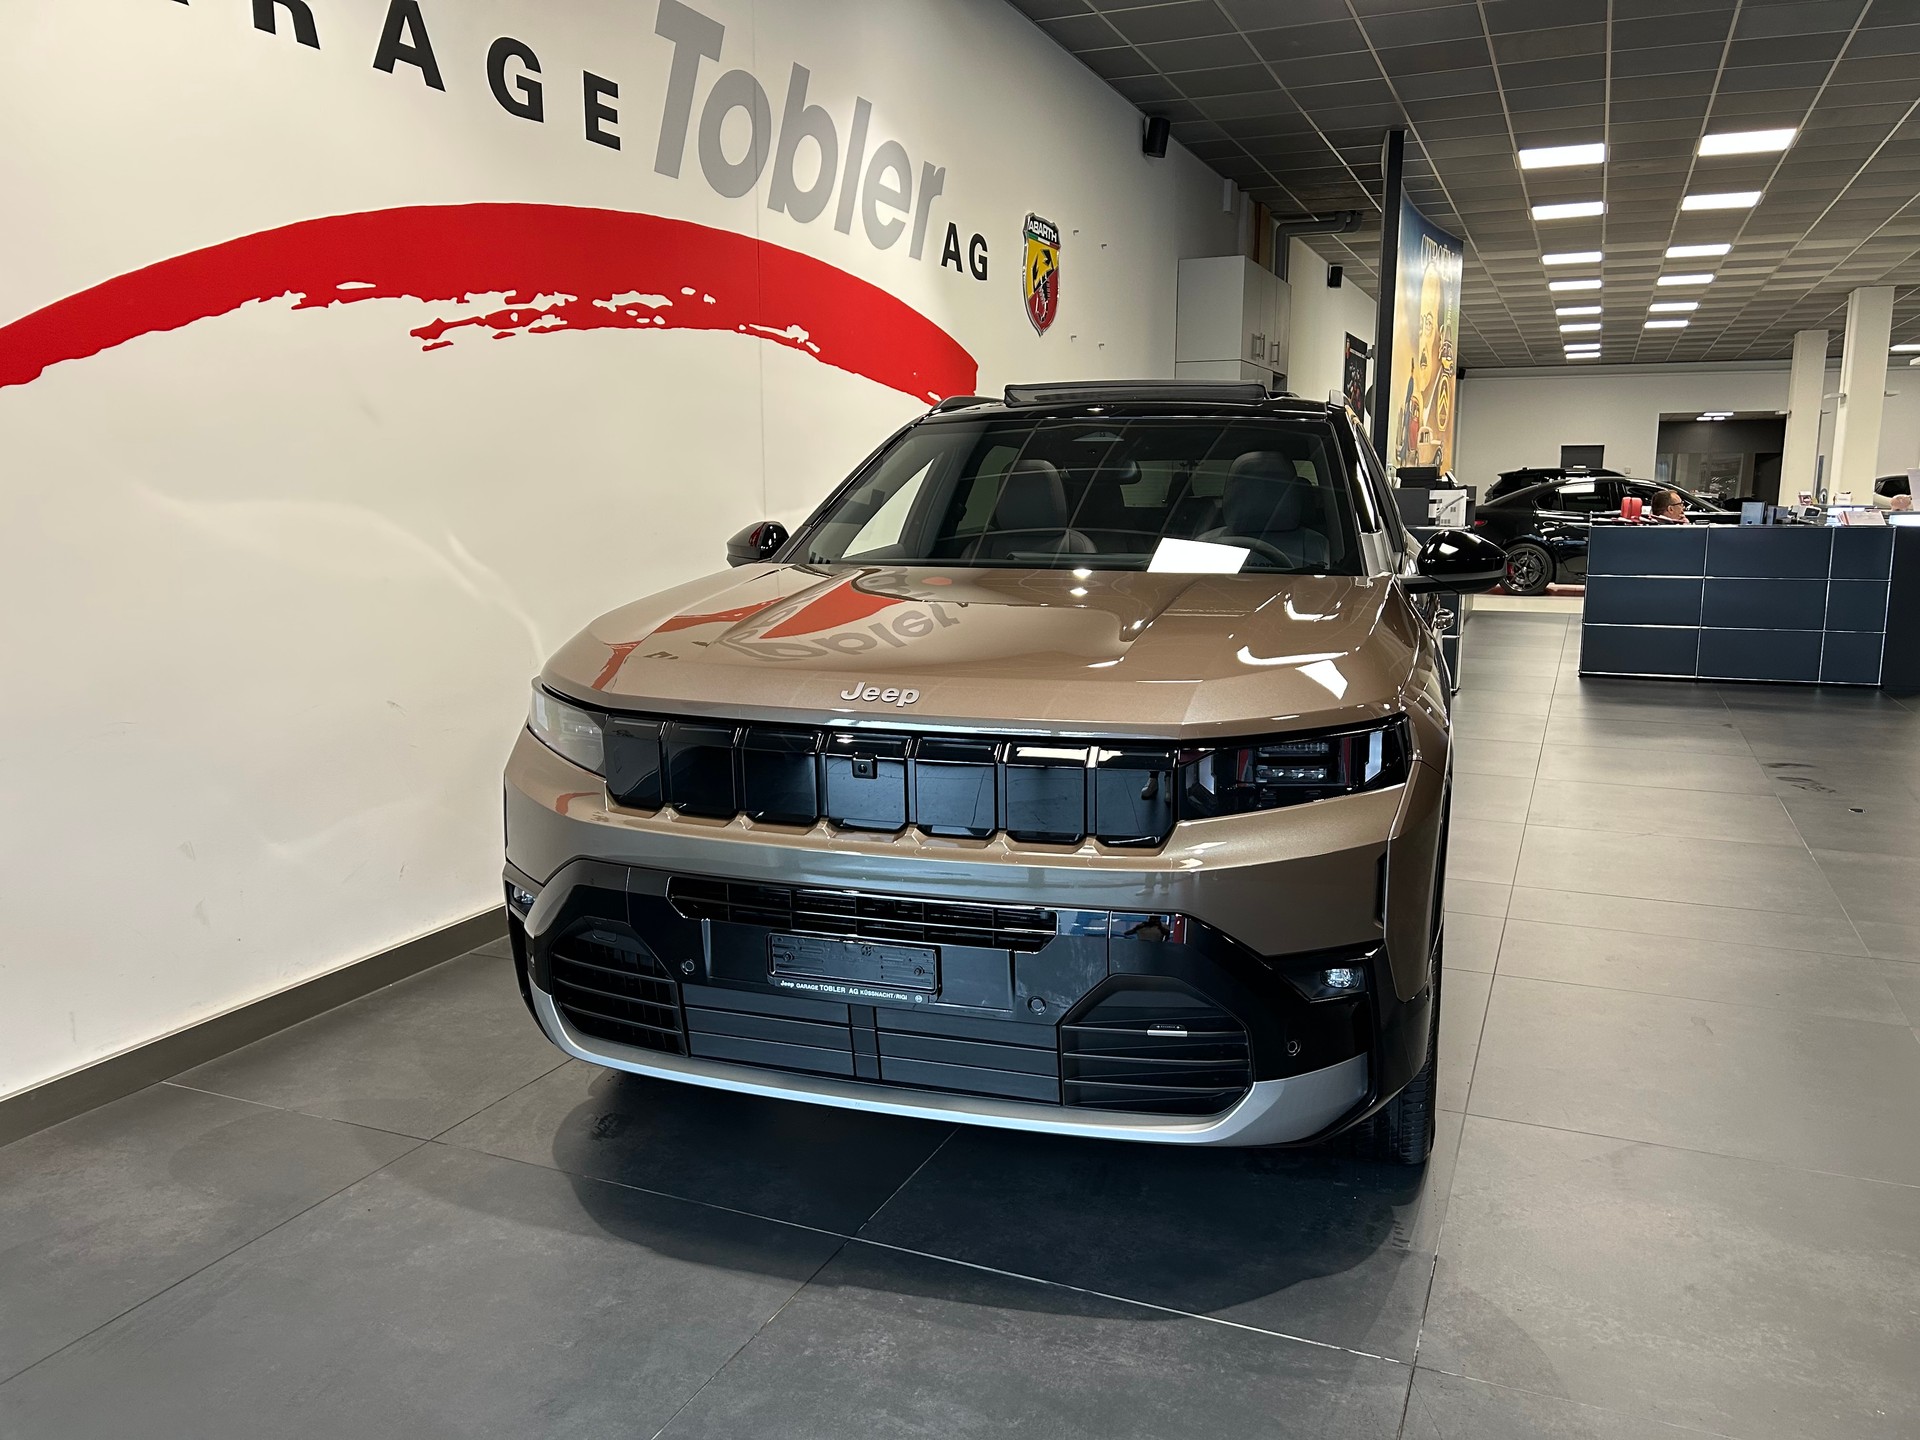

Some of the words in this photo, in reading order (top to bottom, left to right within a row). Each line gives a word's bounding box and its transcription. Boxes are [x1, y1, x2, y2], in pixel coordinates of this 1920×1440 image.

[653, 0, 945, 261] Tobler
[941, 221, 989, 281] AG
[1028, 220, 1058, 243] ABARTH
[840, 682, 920, 708] Jeep
[780, 980, 794, 988] Jeep
[795, 983, 819, 991] GARAGE
[819, 984, 846, 994] TOBLER
[848, 987, 859, 995] AG
